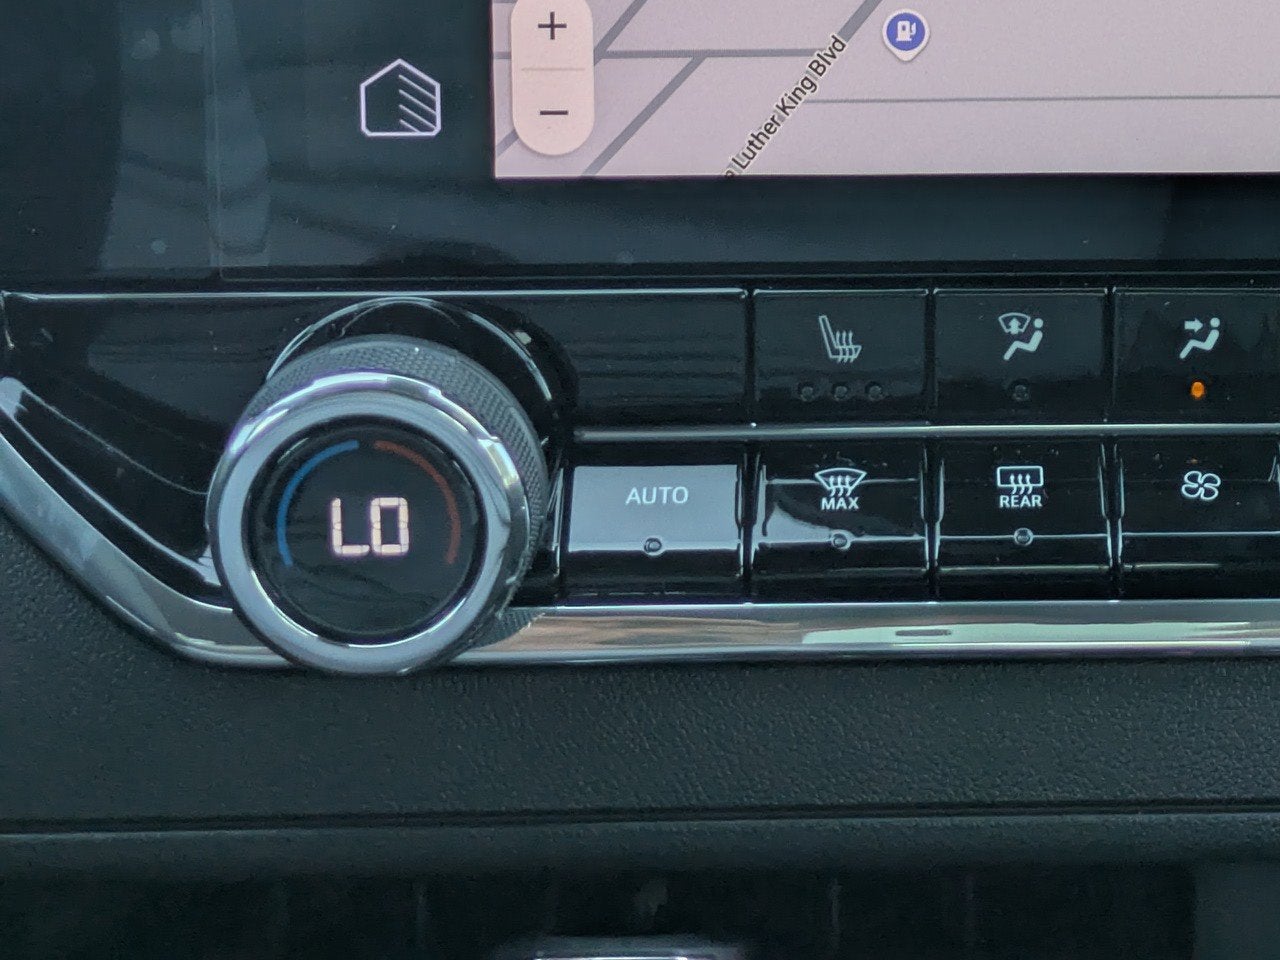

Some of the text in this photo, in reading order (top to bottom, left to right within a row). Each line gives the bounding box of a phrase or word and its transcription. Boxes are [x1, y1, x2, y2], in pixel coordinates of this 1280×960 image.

[731, 34, 846, 170] Luther King Blvd
[624, 484, 690, 507] AUTO
[820, 494, 860, 511] MAX
[999, 493, 1043, 510] REAR
